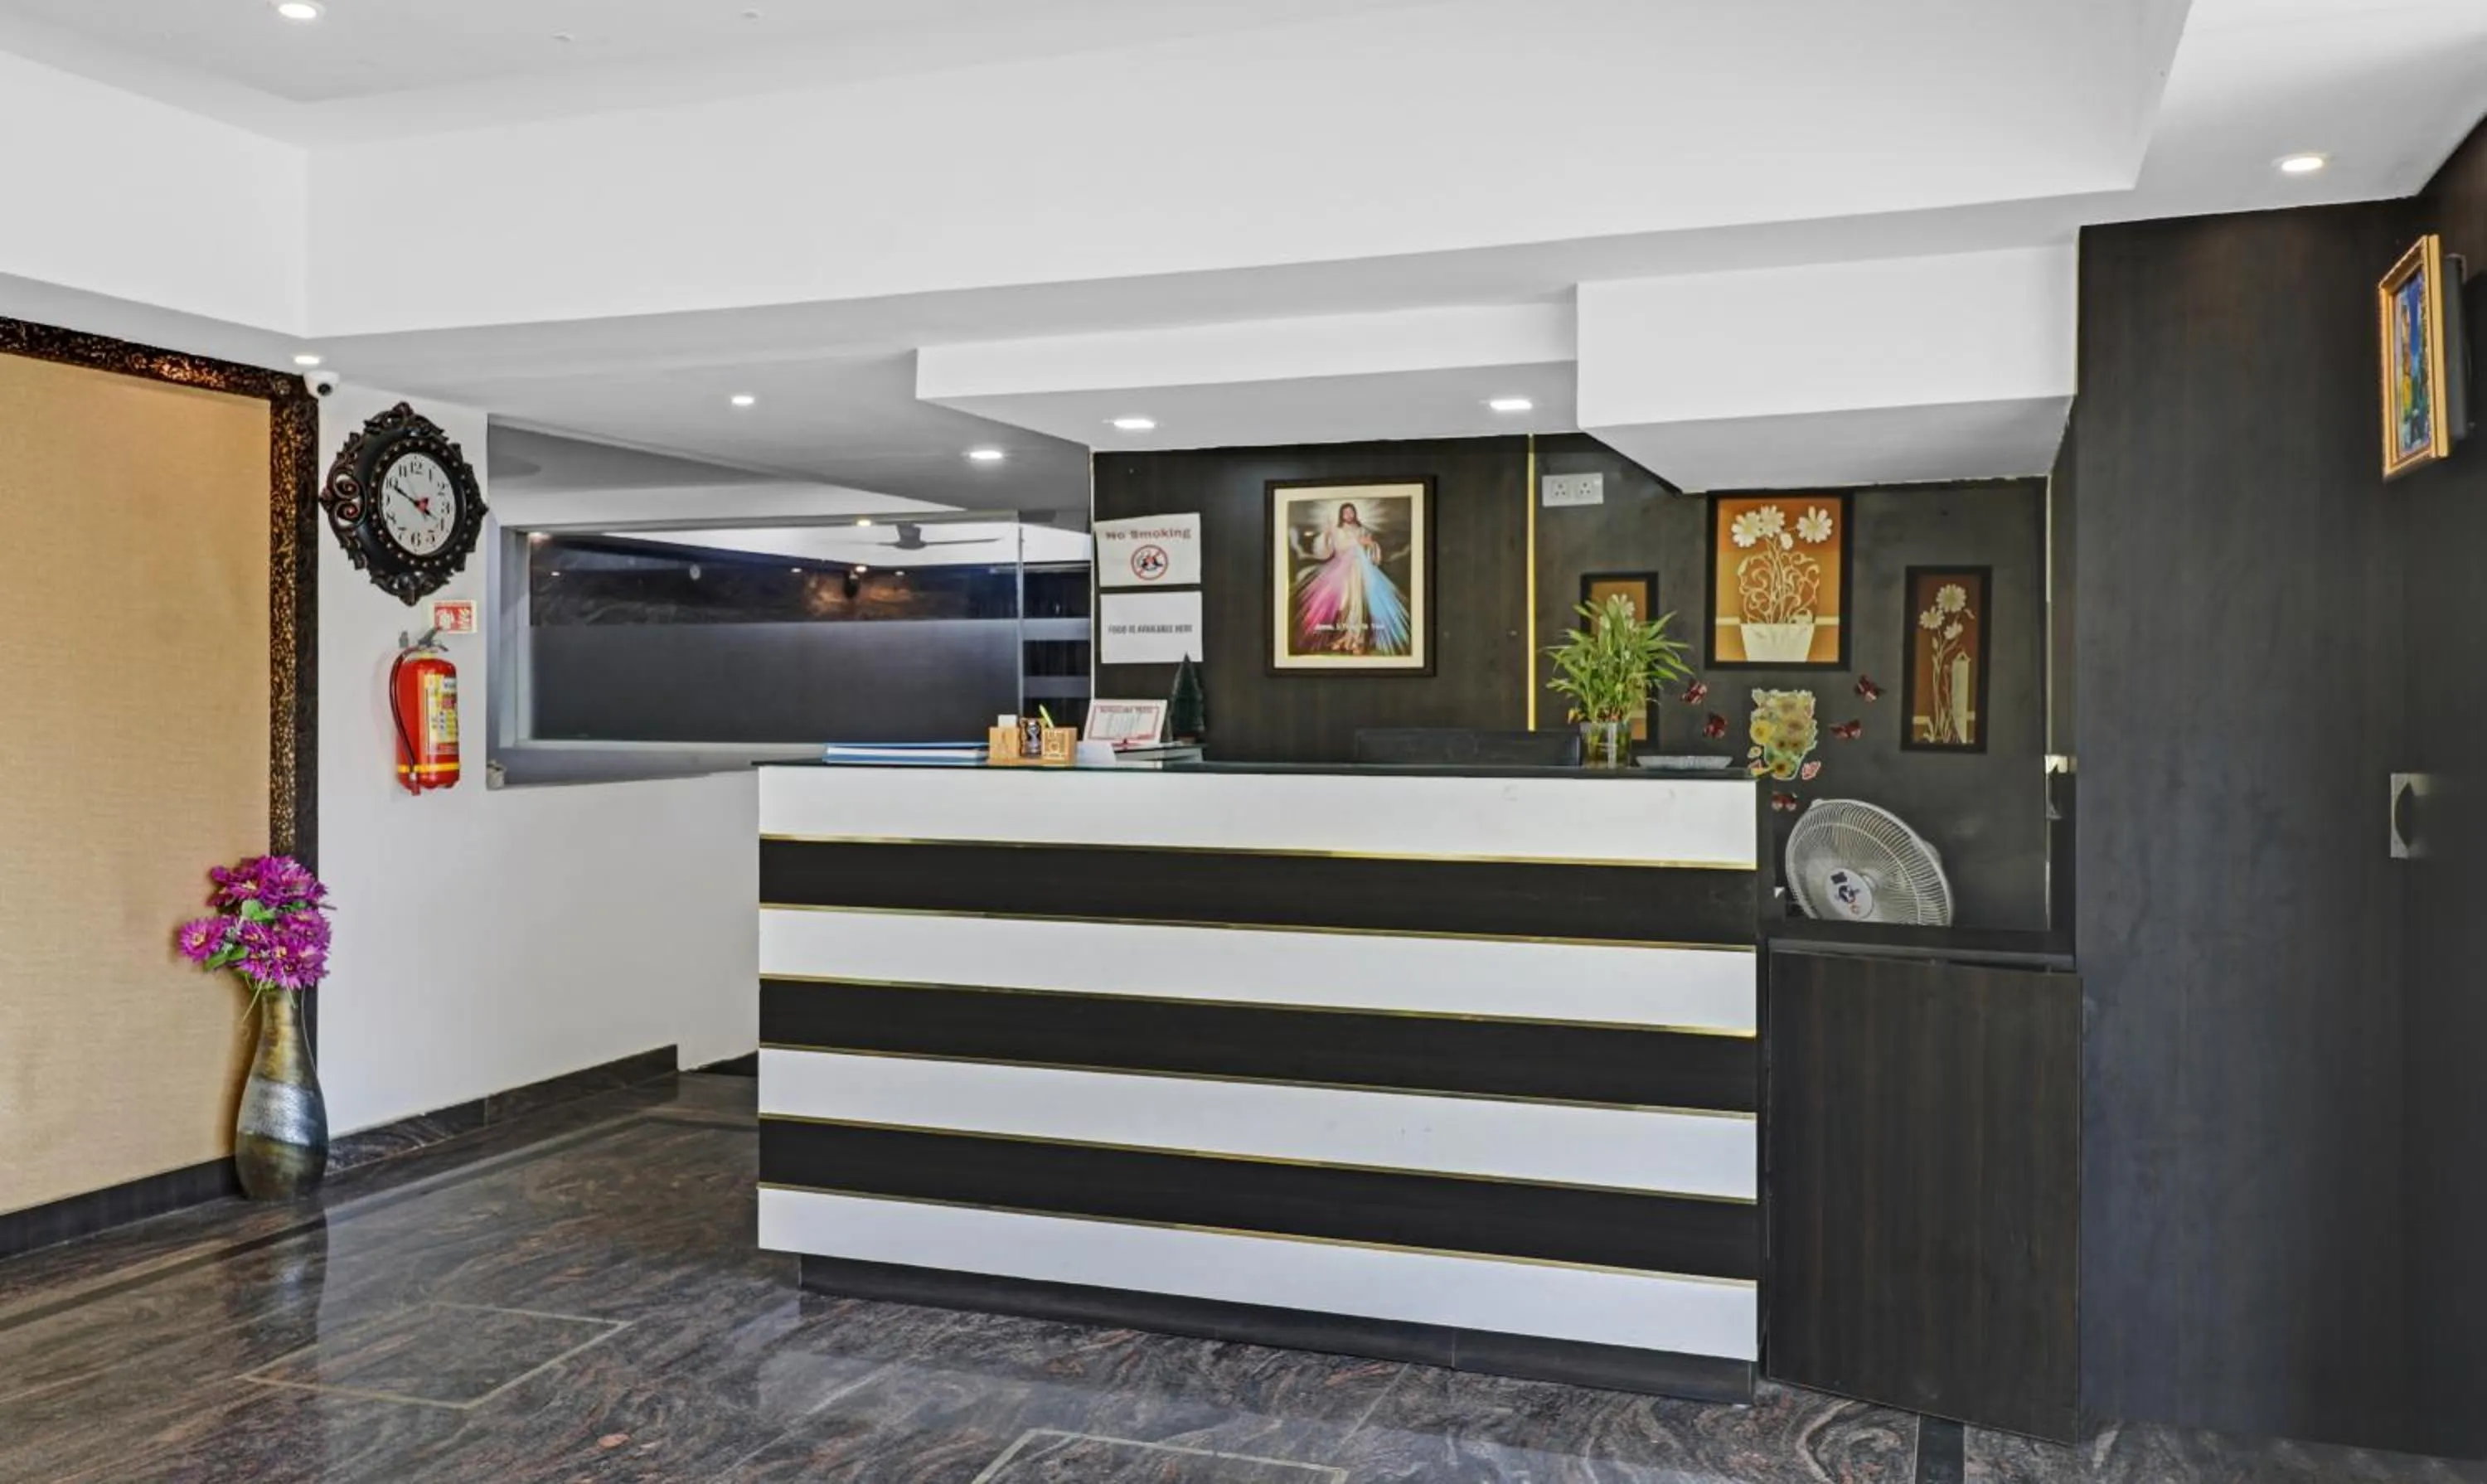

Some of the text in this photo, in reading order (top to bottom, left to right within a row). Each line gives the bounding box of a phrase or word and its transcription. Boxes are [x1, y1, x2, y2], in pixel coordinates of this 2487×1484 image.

[398, 464, 407, 478] 11
[410, 461, 423, 475] 12
[441, 501, 451, 515] 3
[410, 531, 421, 547] 6
[1105, 528, 1192, 541] No Smoking
[1108, 623, 1193, 635] FOOD IS AVAILABLE HERE
